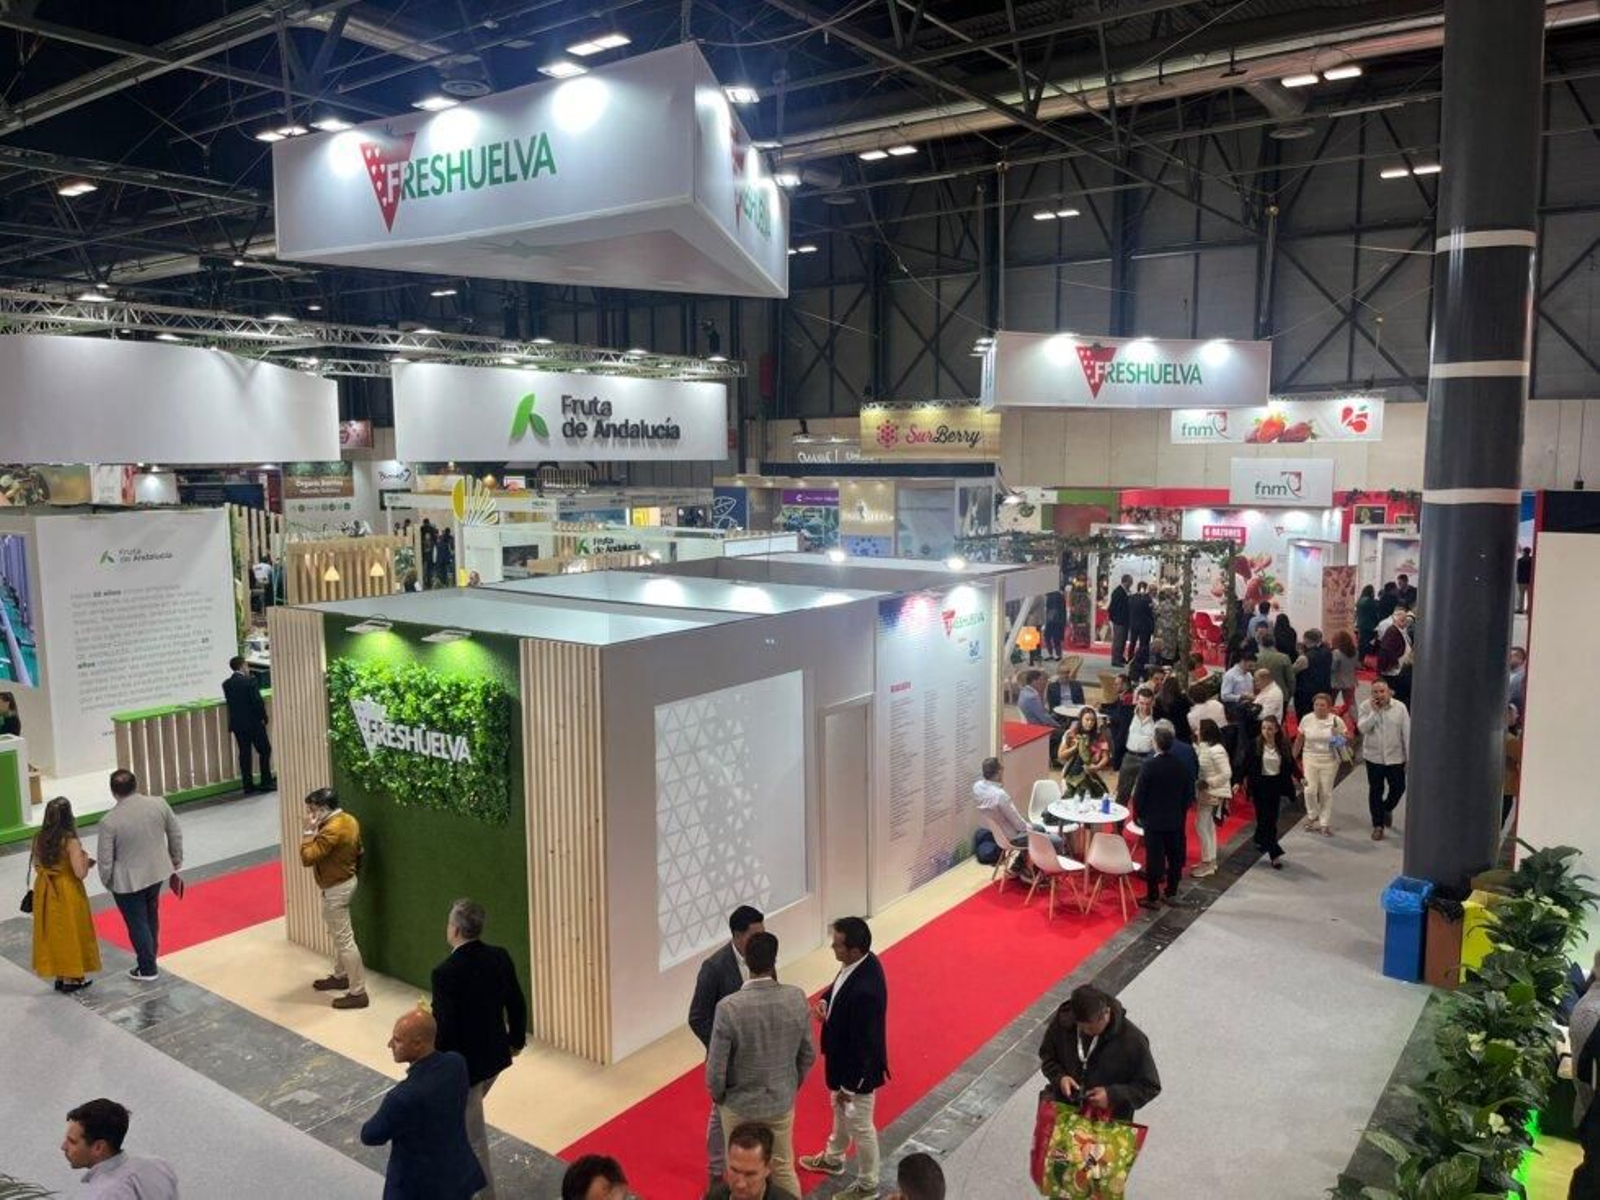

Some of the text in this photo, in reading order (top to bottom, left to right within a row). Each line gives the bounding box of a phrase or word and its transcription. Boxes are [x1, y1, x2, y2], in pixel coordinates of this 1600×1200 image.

[386, 132, 557, 204] FRESHUELVA
[1094, 360, 1203, 385] FRESHUELVA
[561, 395, 612, 416] Fruta
[562, 418, 681, 440] de Andalucía
[905, 424, 981, 448] SurBerry
[1181, 423, 1213, 436] fnm
[1254, 481, 1287, 495] fnm
[368, 719, 473, 764] FRESHUELVA
